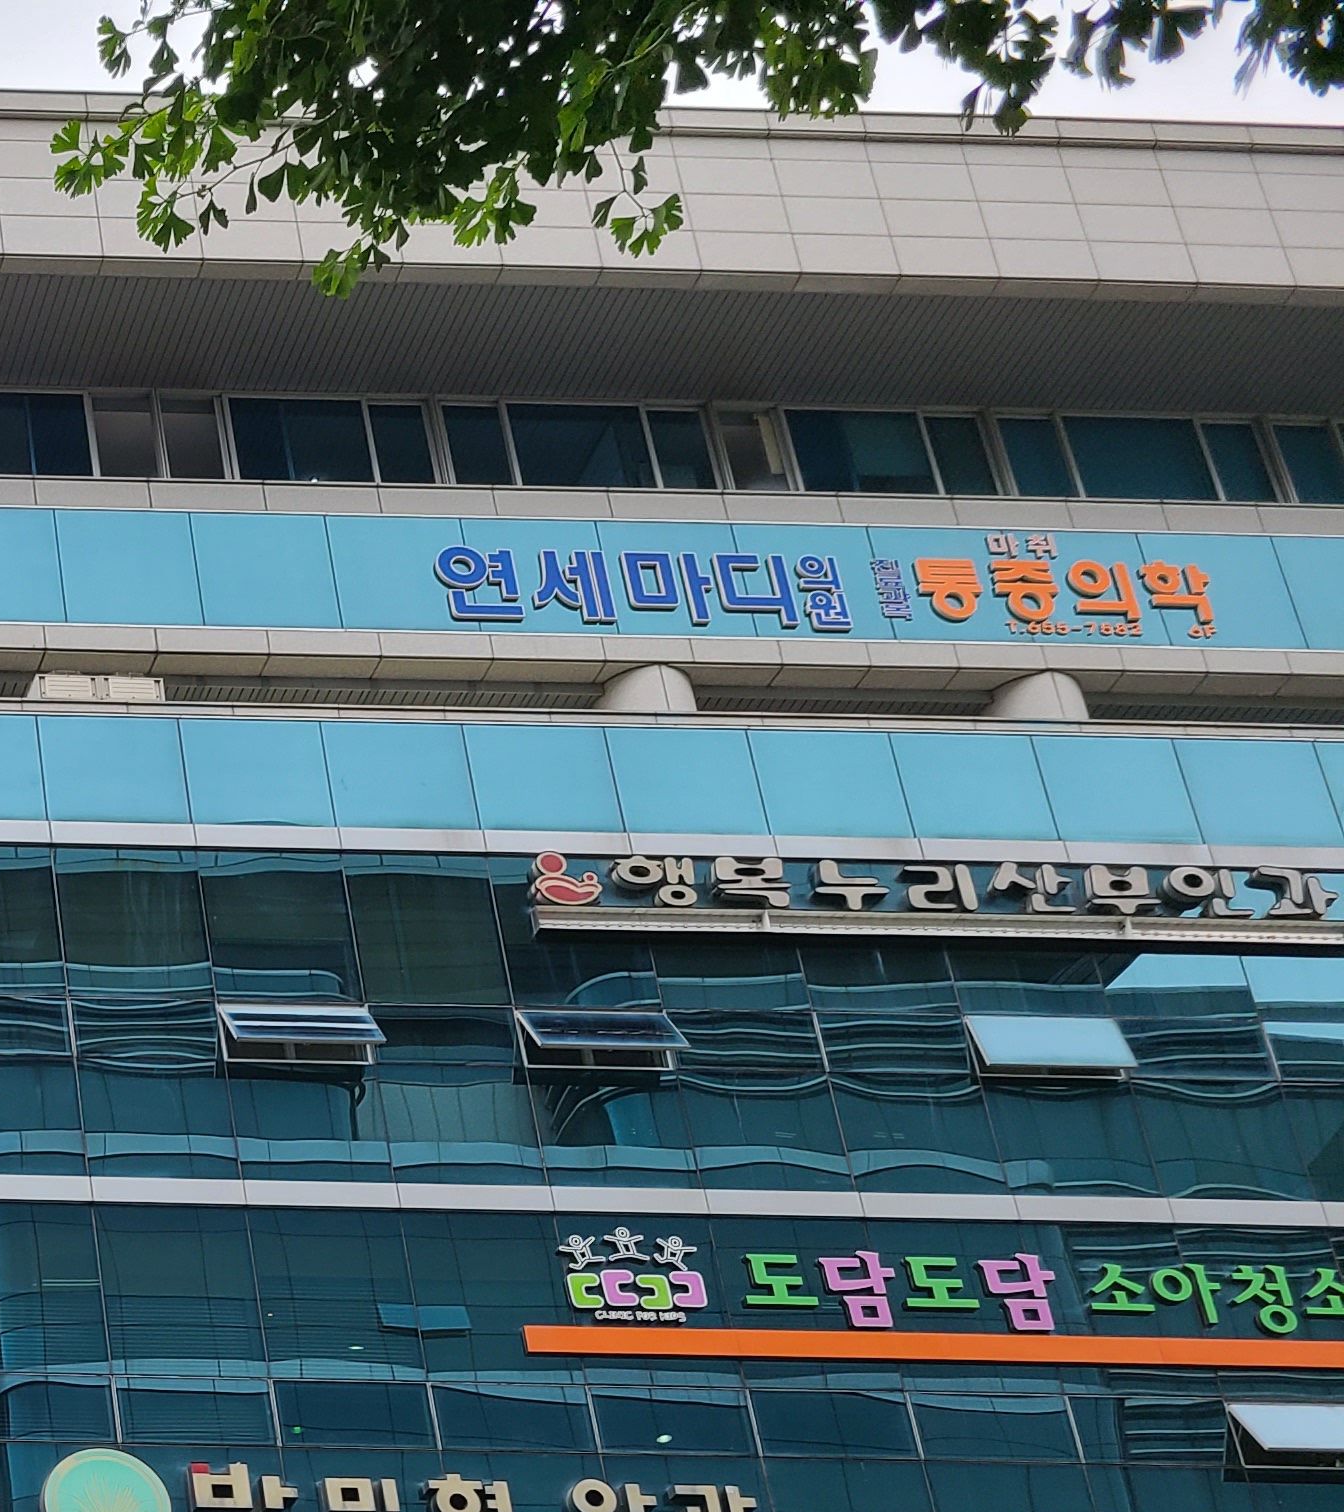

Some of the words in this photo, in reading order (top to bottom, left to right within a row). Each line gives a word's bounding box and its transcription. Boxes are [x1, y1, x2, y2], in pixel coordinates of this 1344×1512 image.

[913, 558, 1214, 624] 통증의학
[612, 853, 1340, 921] 행복누리산부인과
[744, 1250, 1056, 1332] 도담도담
